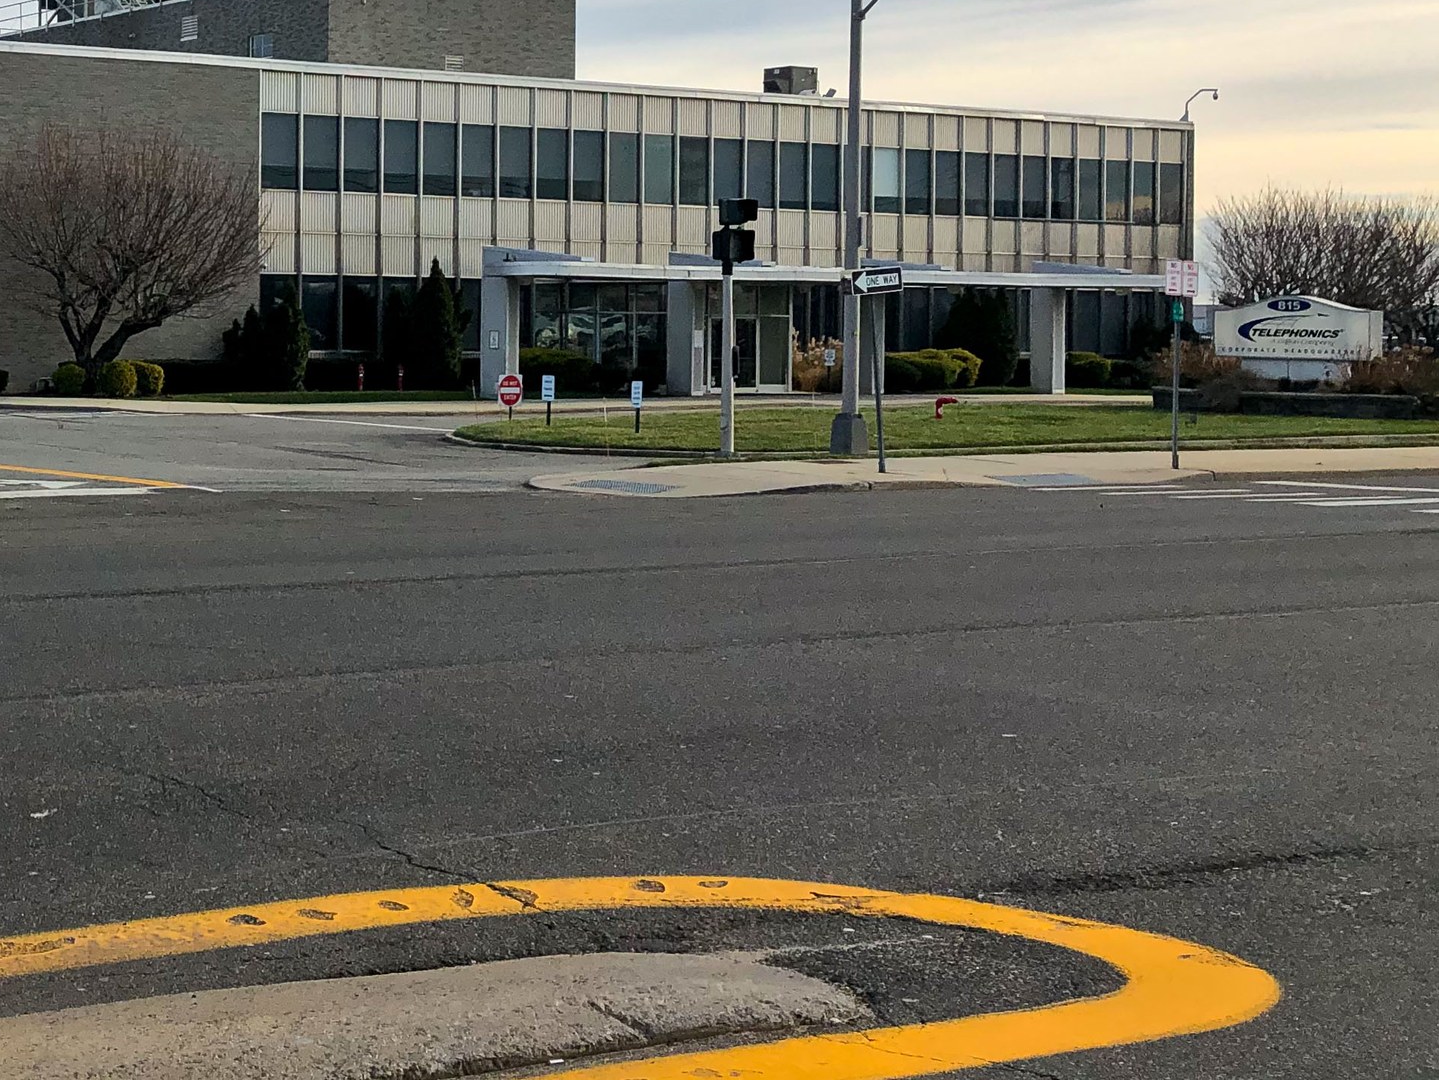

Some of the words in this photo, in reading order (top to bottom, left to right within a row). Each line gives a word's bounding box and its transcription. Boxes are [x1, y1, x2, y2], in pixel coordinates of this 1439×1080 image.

[866, 277, 879, 286] ONE
[883, 275, 897, 284] WAY
[1278, 301, 1300, 310] 815
[1251, 328, 1340, 338] TELEPHONICS
